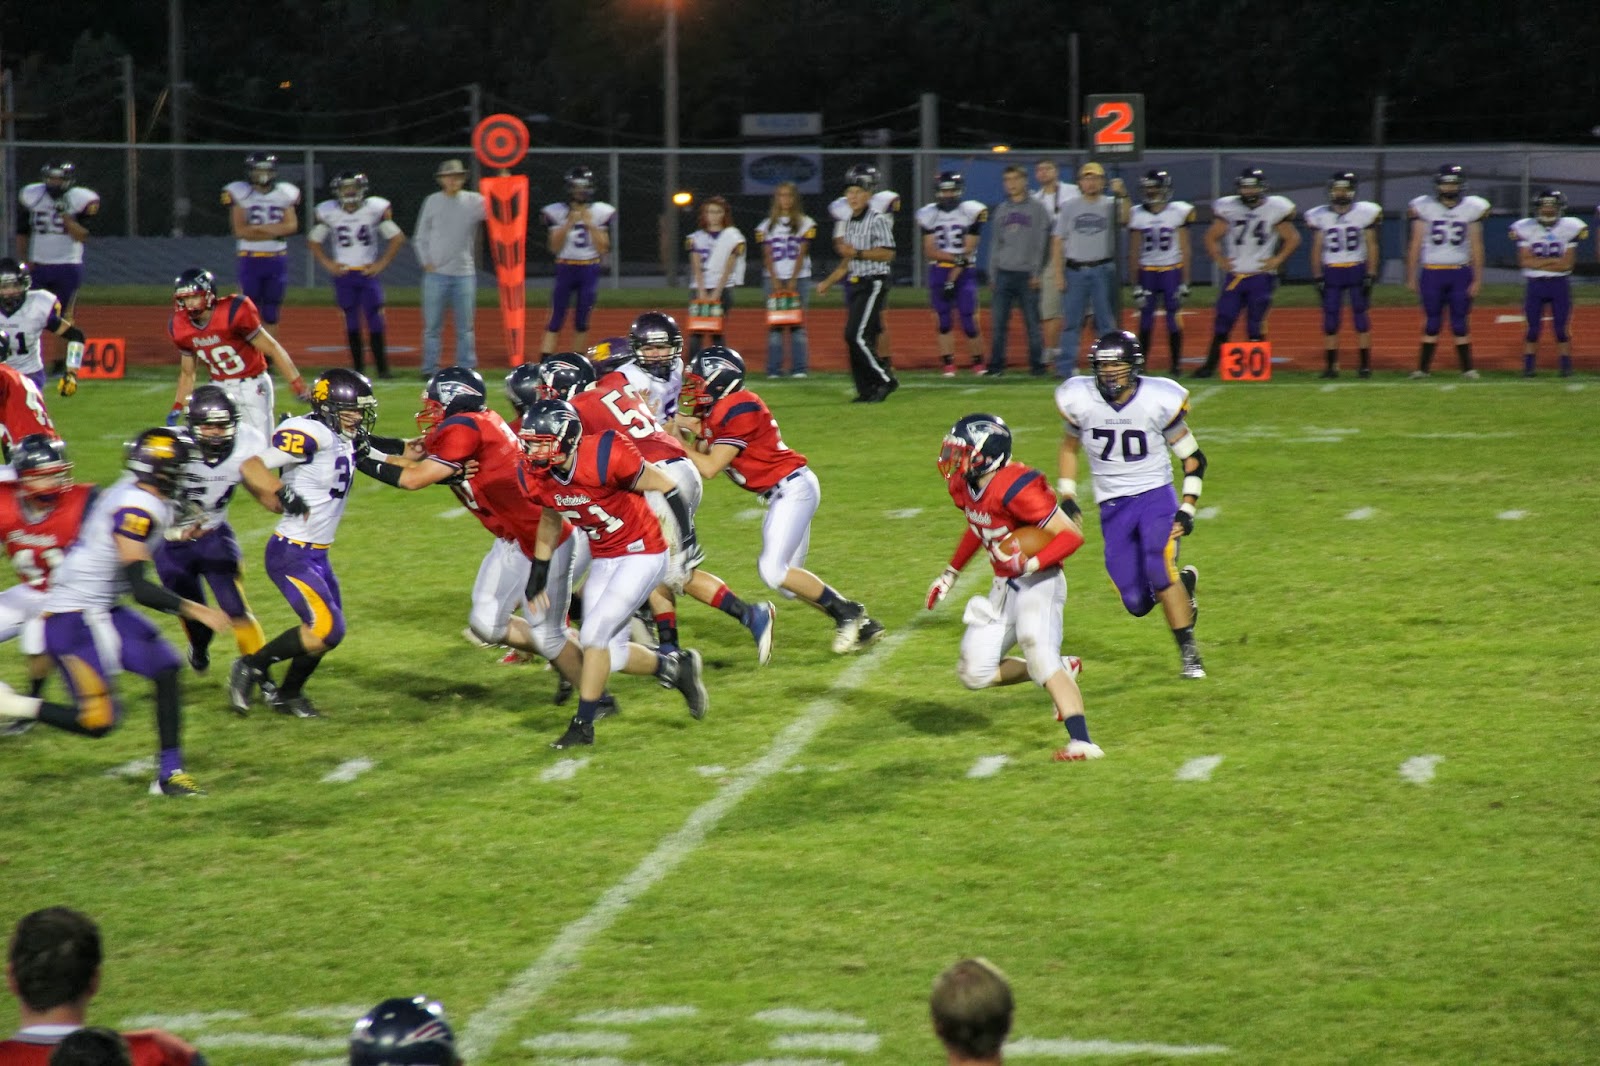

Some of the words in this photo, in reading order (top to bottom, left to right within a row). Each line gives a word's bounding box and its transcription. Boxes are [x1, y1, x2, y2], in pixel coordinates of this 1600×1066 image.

[1094, 102, 1135, 144] 2
[1234, 220, 1268, 245] 74
[1431, 220, 1466, 246] 53
[84, 343, 119, 373] 40
[1229, 347, 1265, 377] 30
[279, 432, 305, 454] 32
[1092, 428, 1148, 462] 70
[558, 504, 625, 541] 51
